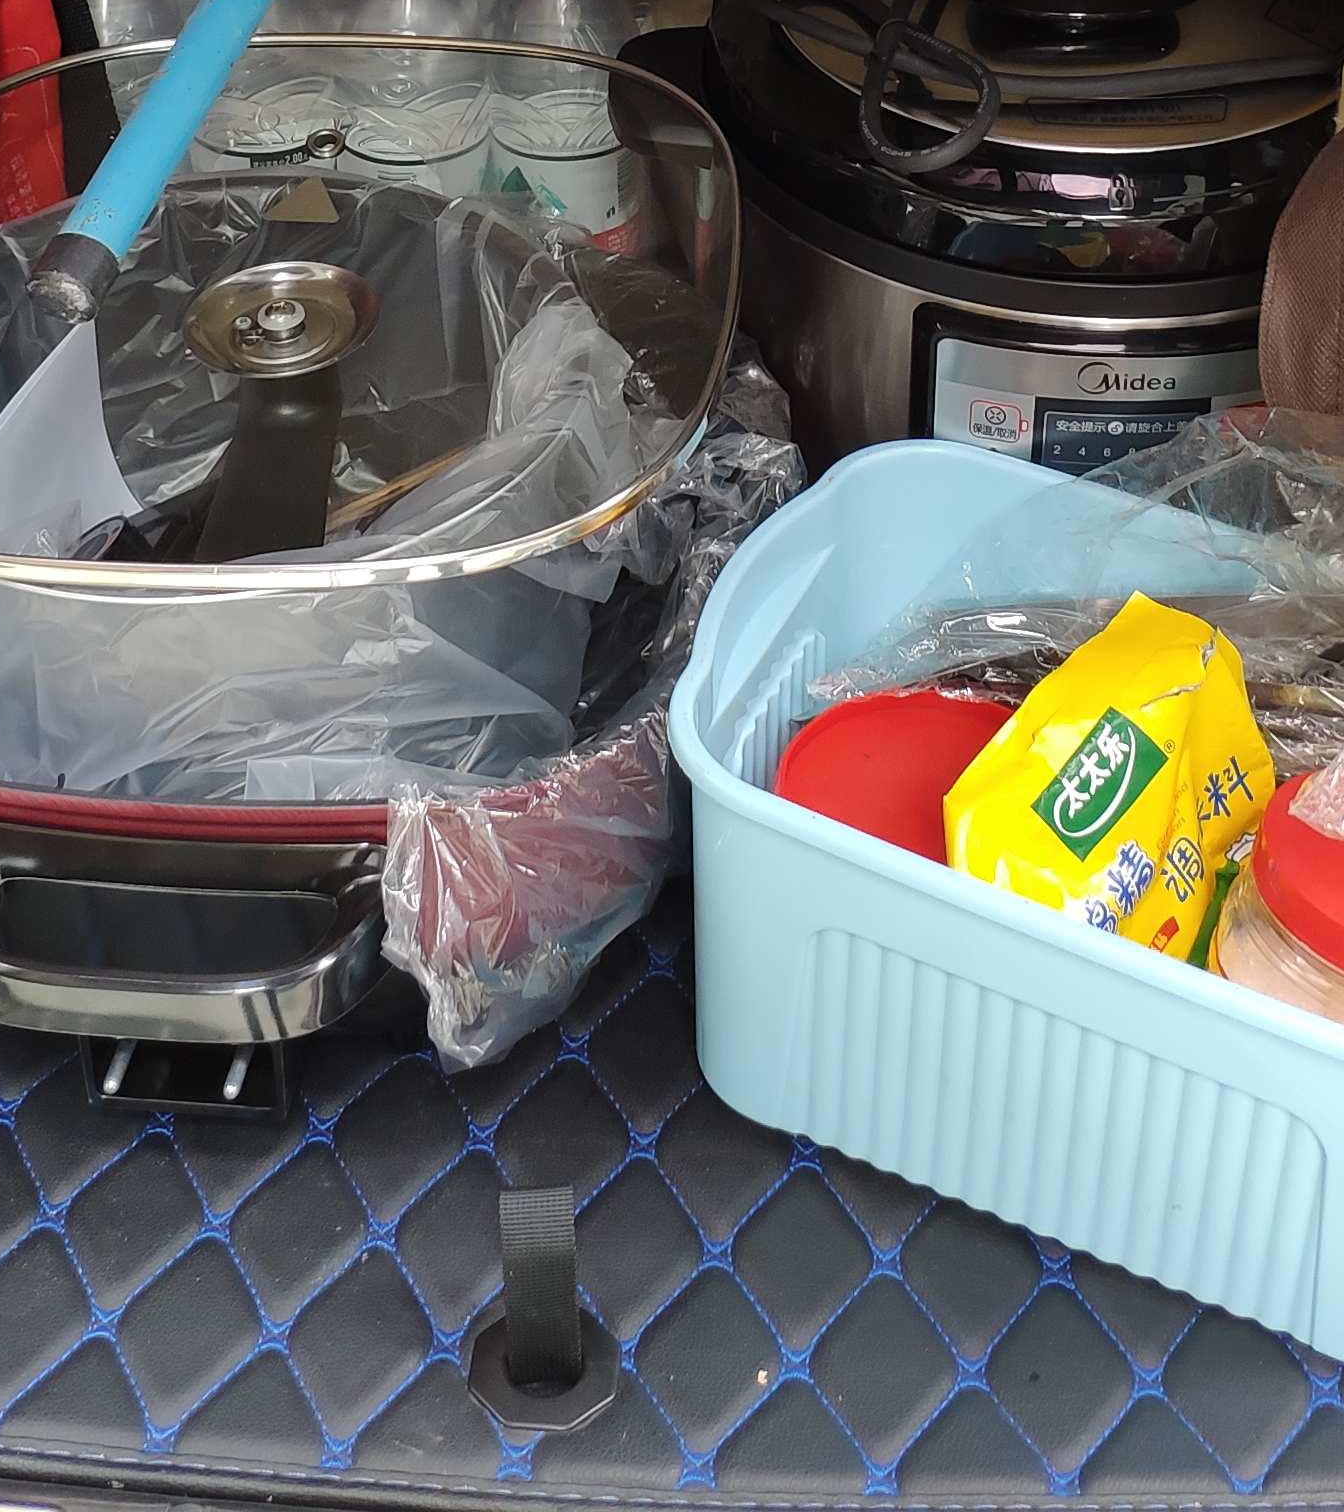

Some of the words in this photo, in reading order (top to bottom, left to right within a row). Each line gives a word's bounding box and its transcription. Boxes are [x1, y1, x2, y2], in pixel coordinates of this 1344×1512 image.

[1077, 361, 1176, 395] Midea
[1053, 445, 1061, 455] 2
[1078, 446, 1086, 456] 4
[1103, 447, 1111, 457] 6
[1060, 724, 1131, 820] 太太乐
